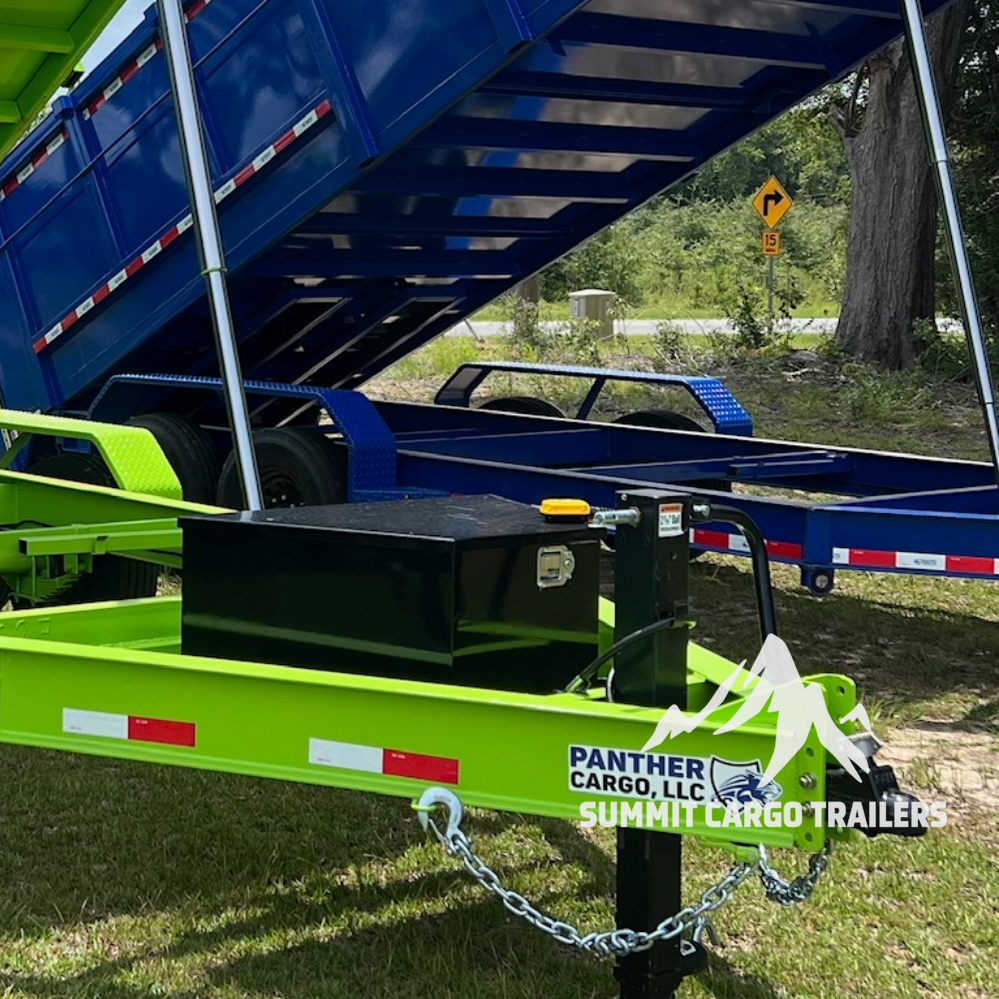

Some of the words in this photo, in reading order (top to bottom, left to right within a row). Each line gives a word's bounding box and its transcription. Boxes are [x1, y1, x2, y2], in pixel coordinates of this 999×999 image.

[765, 234, 776, 246] 15
[570, 746, 705, 780] PANTHER
[571, 771, 657, 799] CARGO,
[663, 780, 705, 801] LLC
